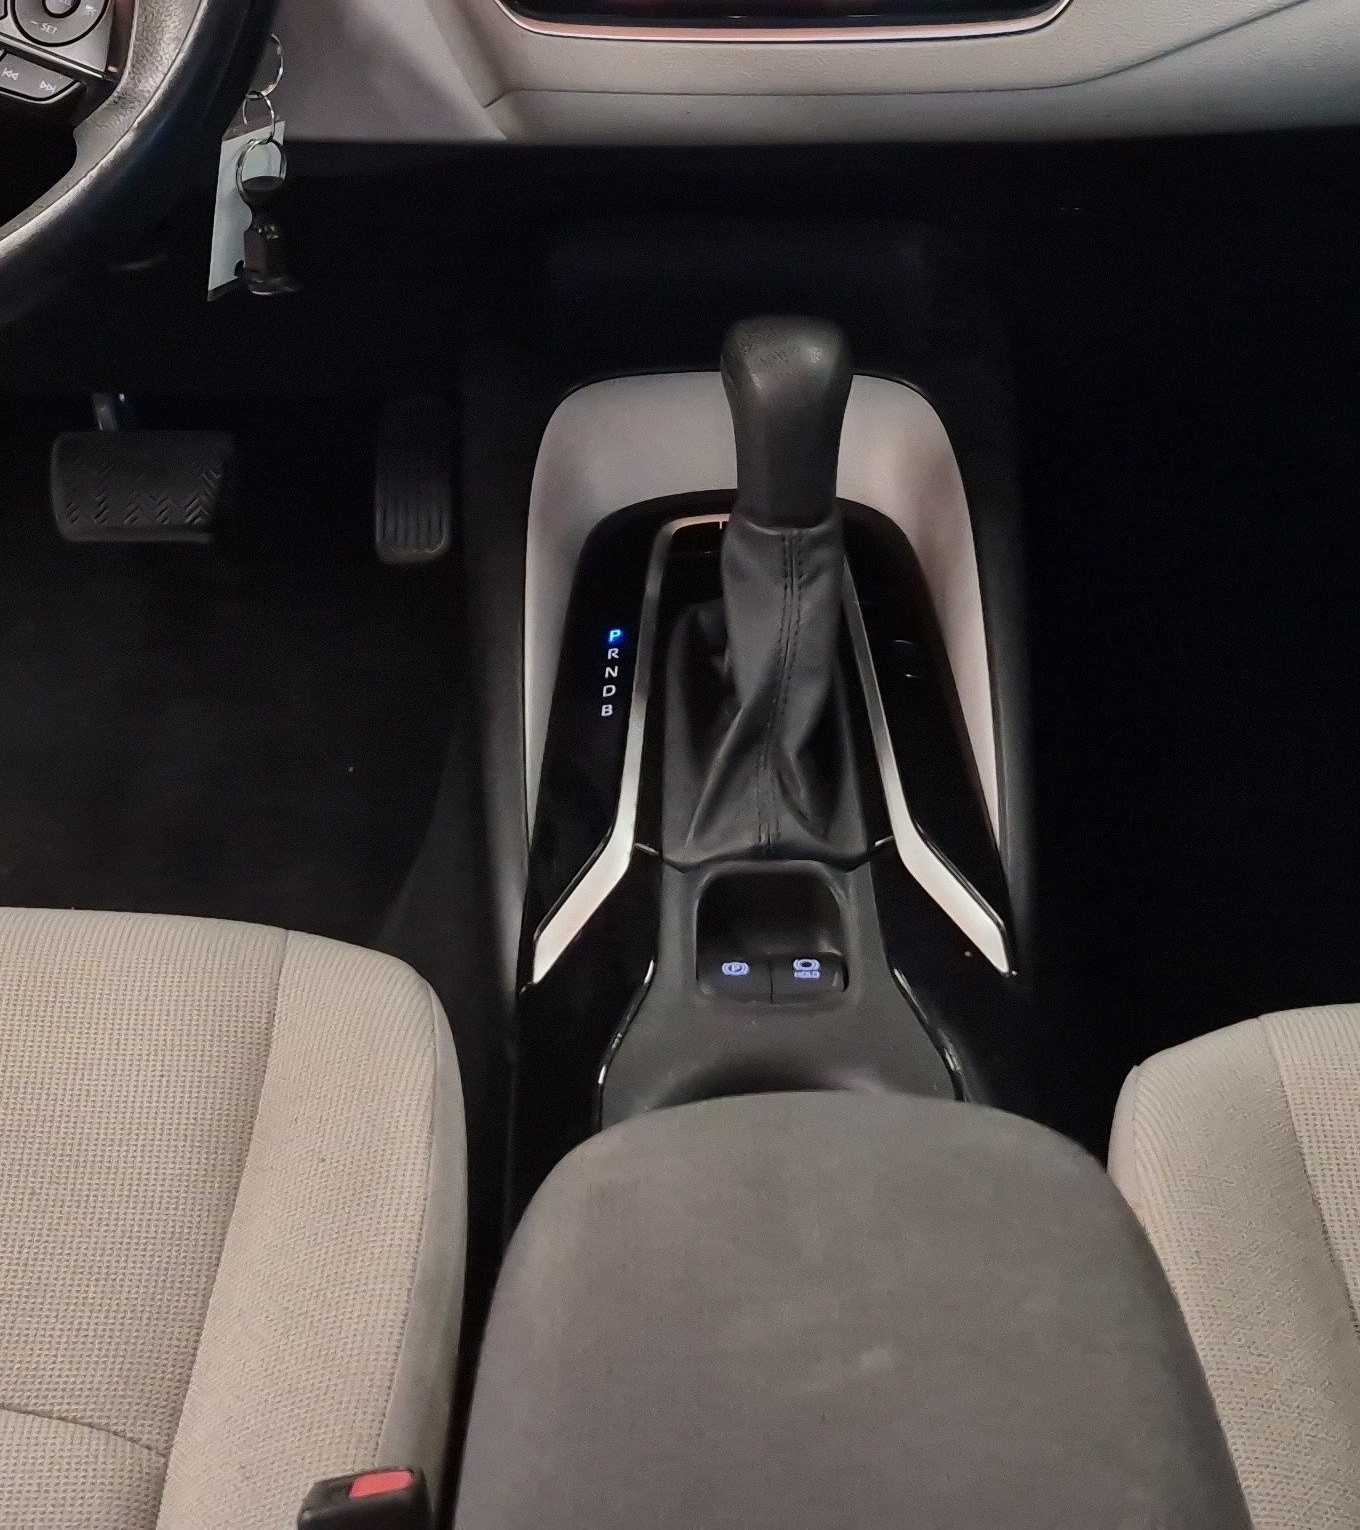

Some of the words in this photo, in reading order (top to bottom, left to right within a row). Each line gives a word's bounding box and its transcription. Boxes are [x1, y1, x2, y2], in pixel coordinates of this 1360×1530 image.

[608, 629, 621, 643] P
[607, 647, 619, 660] R
[605, 665, 618, 679] N
[602, 684, 616, 697] D
[601, 704, 613, 716] B
